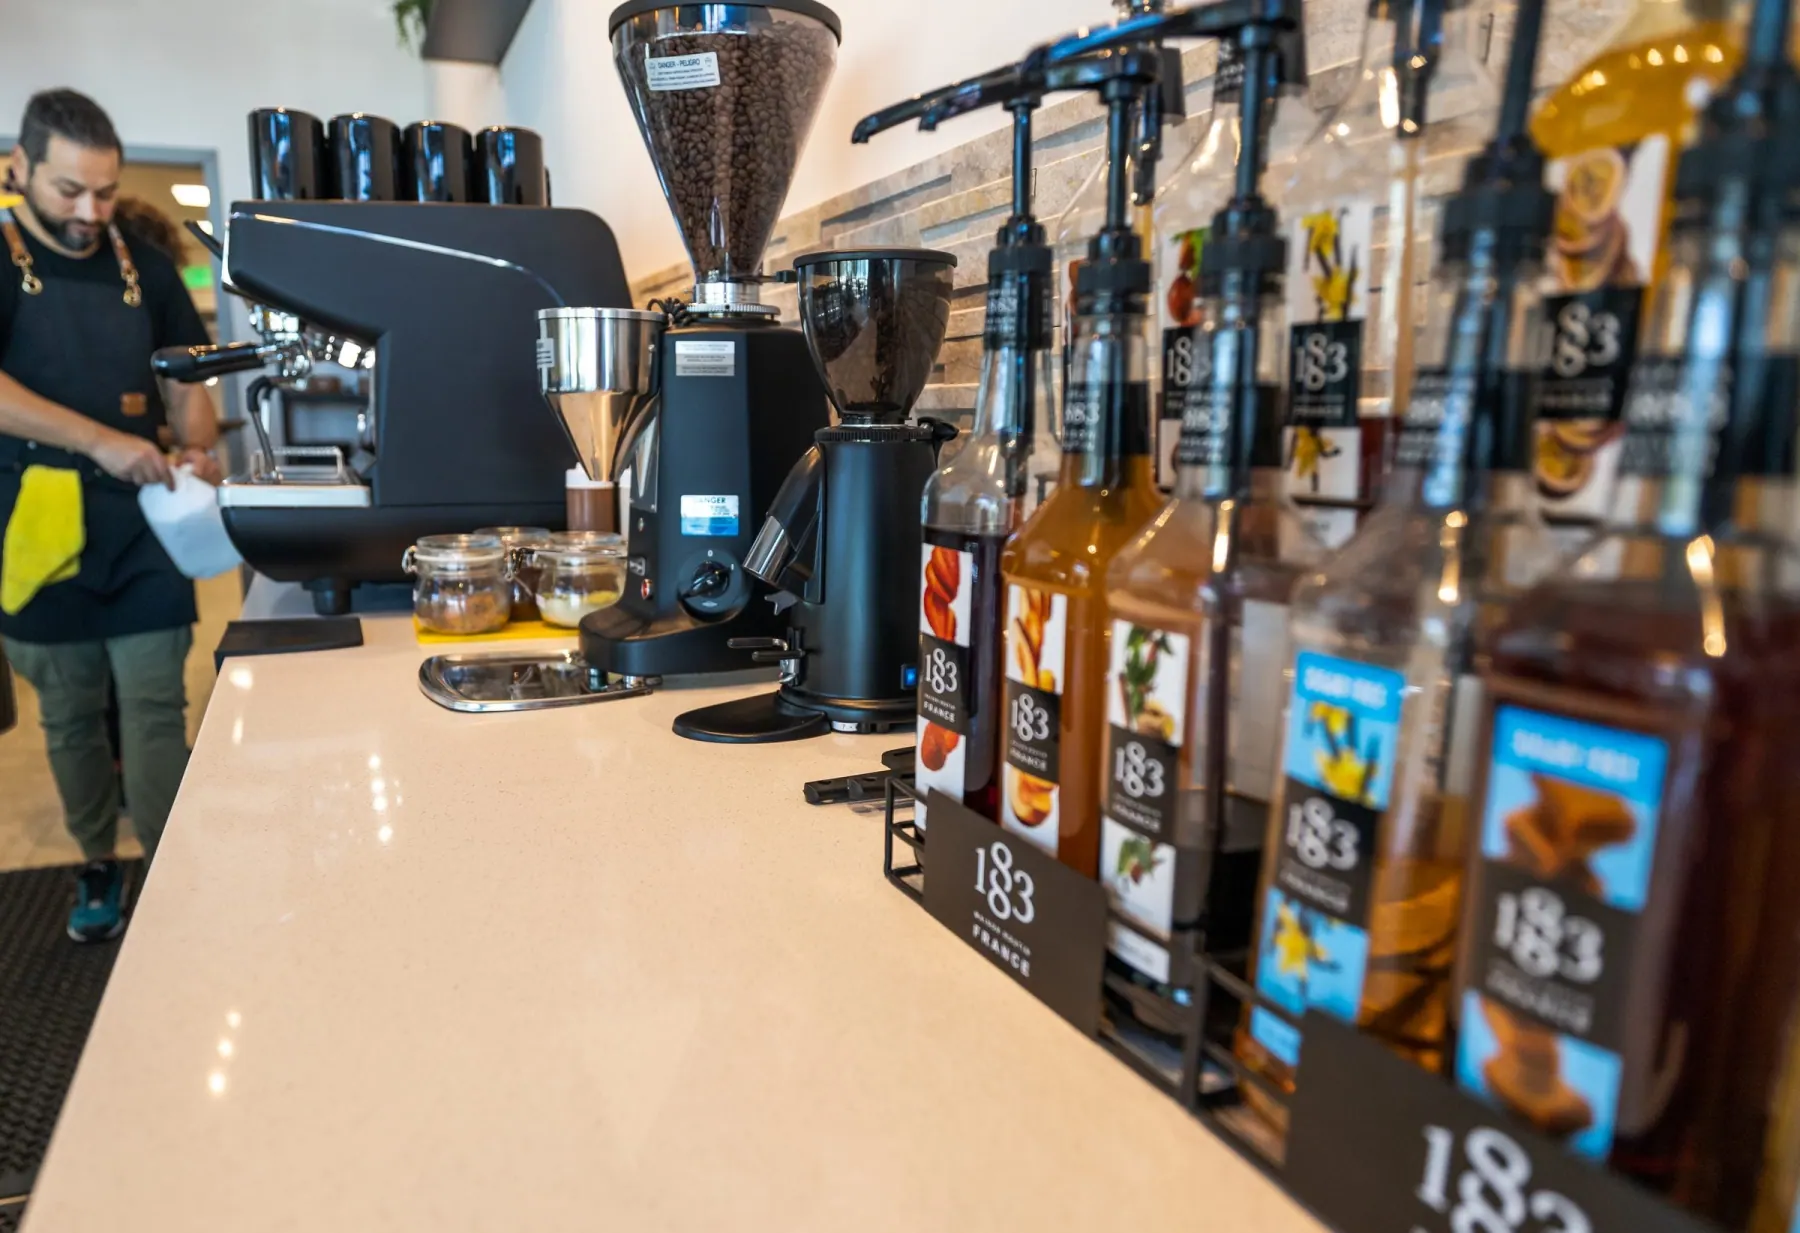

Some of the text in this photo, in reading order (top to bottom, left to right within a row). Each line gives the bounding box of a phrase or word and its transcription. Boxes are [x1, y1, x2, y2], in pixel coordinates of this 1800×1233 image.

[658, 60, 676, 68] DANGER
[1295, 332, 1348, 392] 1883
[926, 647, 958, 695] 1883
[923, 700, 956, 724] FRANCE
[1011, 693, 1050, 742] 1883
[1115, 741, 1165, 798] 1883
[974, 841, 1035, 924] 1883
[972, 923, 1031, 978] FRANCE
